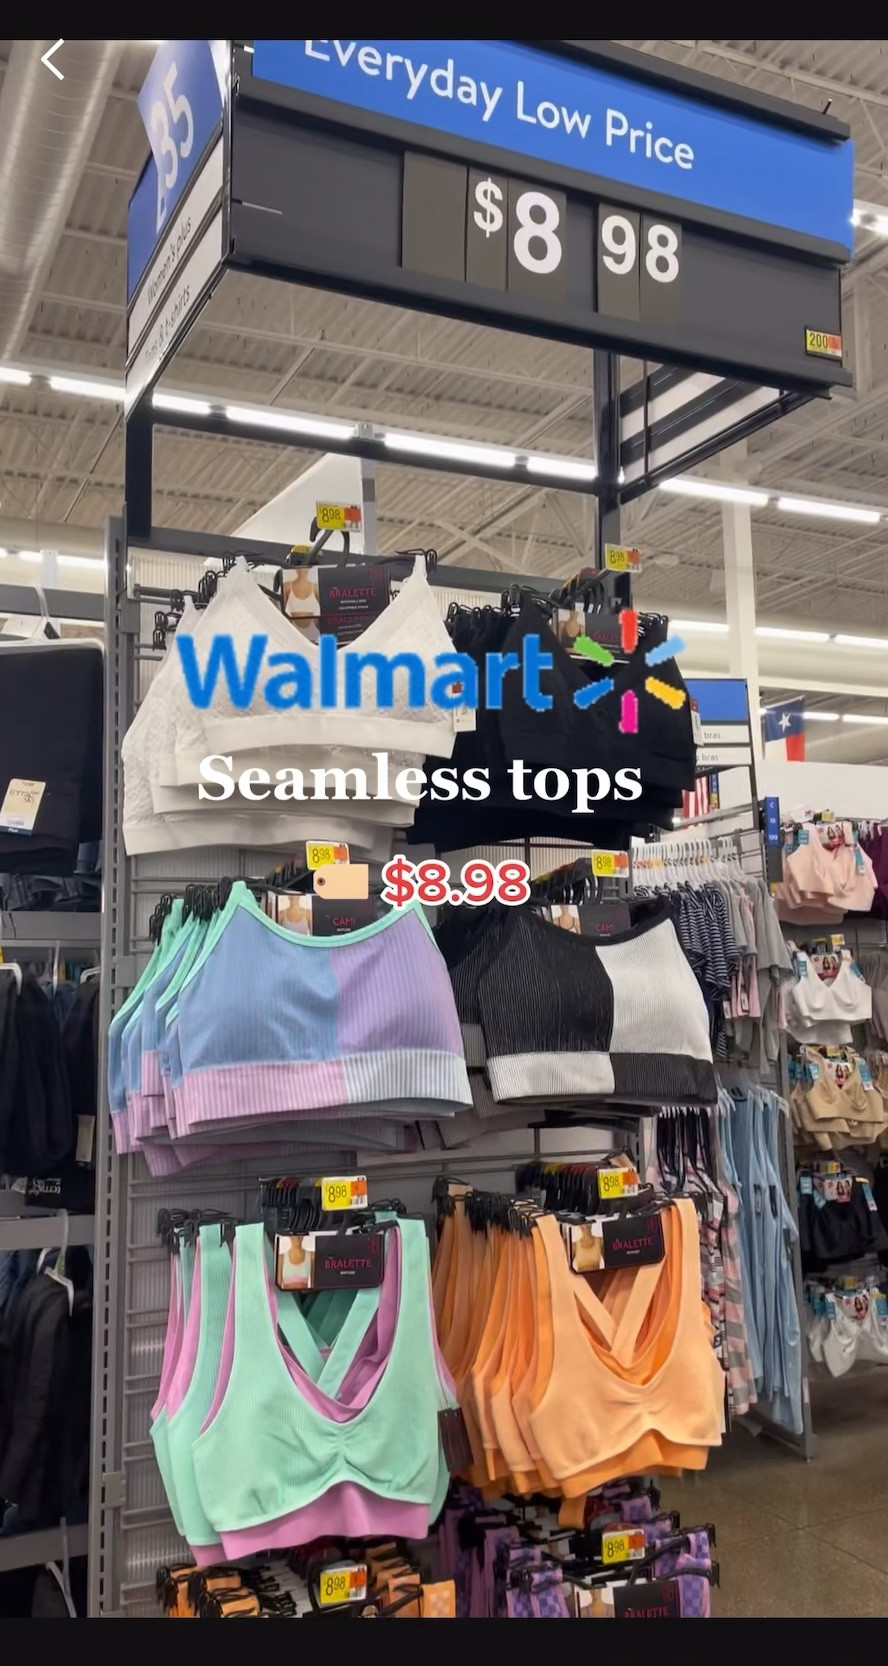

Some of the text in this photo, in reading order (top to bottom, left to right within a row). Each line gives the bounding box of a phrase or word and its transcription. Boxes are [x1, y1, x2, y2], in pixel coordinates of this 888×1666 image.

[516, 81, 592, 139] Low
[605, 108, 695, 170] Price
[152, 62, 194, 234] 35
[329, 588, 376, 599] BRALETTE
[332, 917, 356, 926] CAMI
[612, 1236, 653, 1251] BRALETTE
[324, 1258, 373, 1269] BRALETTE
